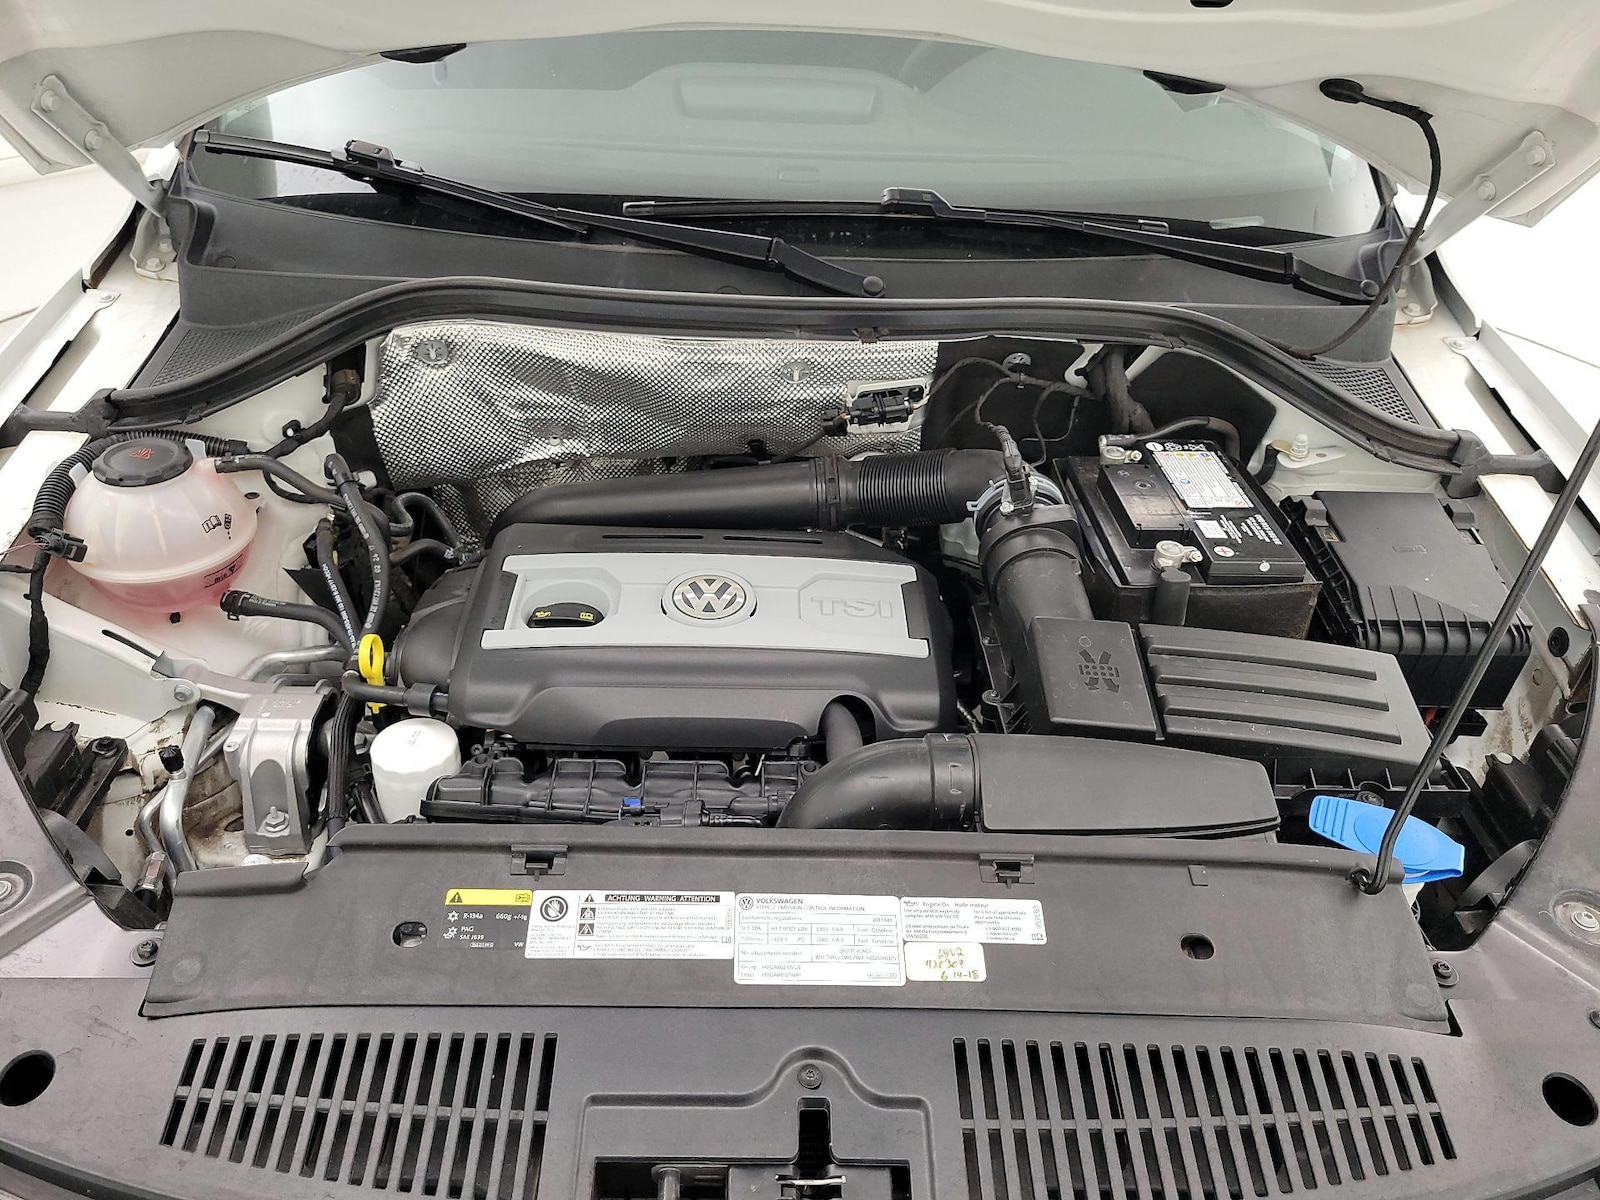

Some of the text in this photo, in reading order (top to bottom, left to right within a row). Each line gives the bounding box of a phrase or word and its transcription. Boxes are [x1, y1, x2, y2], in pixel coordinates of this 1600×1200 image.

[214, 574, 228, 584] min
[810, 597, 893, 619] TSI
[755, 897, 804, 905] VOLKSWAGEN
[463, 912, 484, 920] R-134a
[495, 912, 512, 921] 660g
